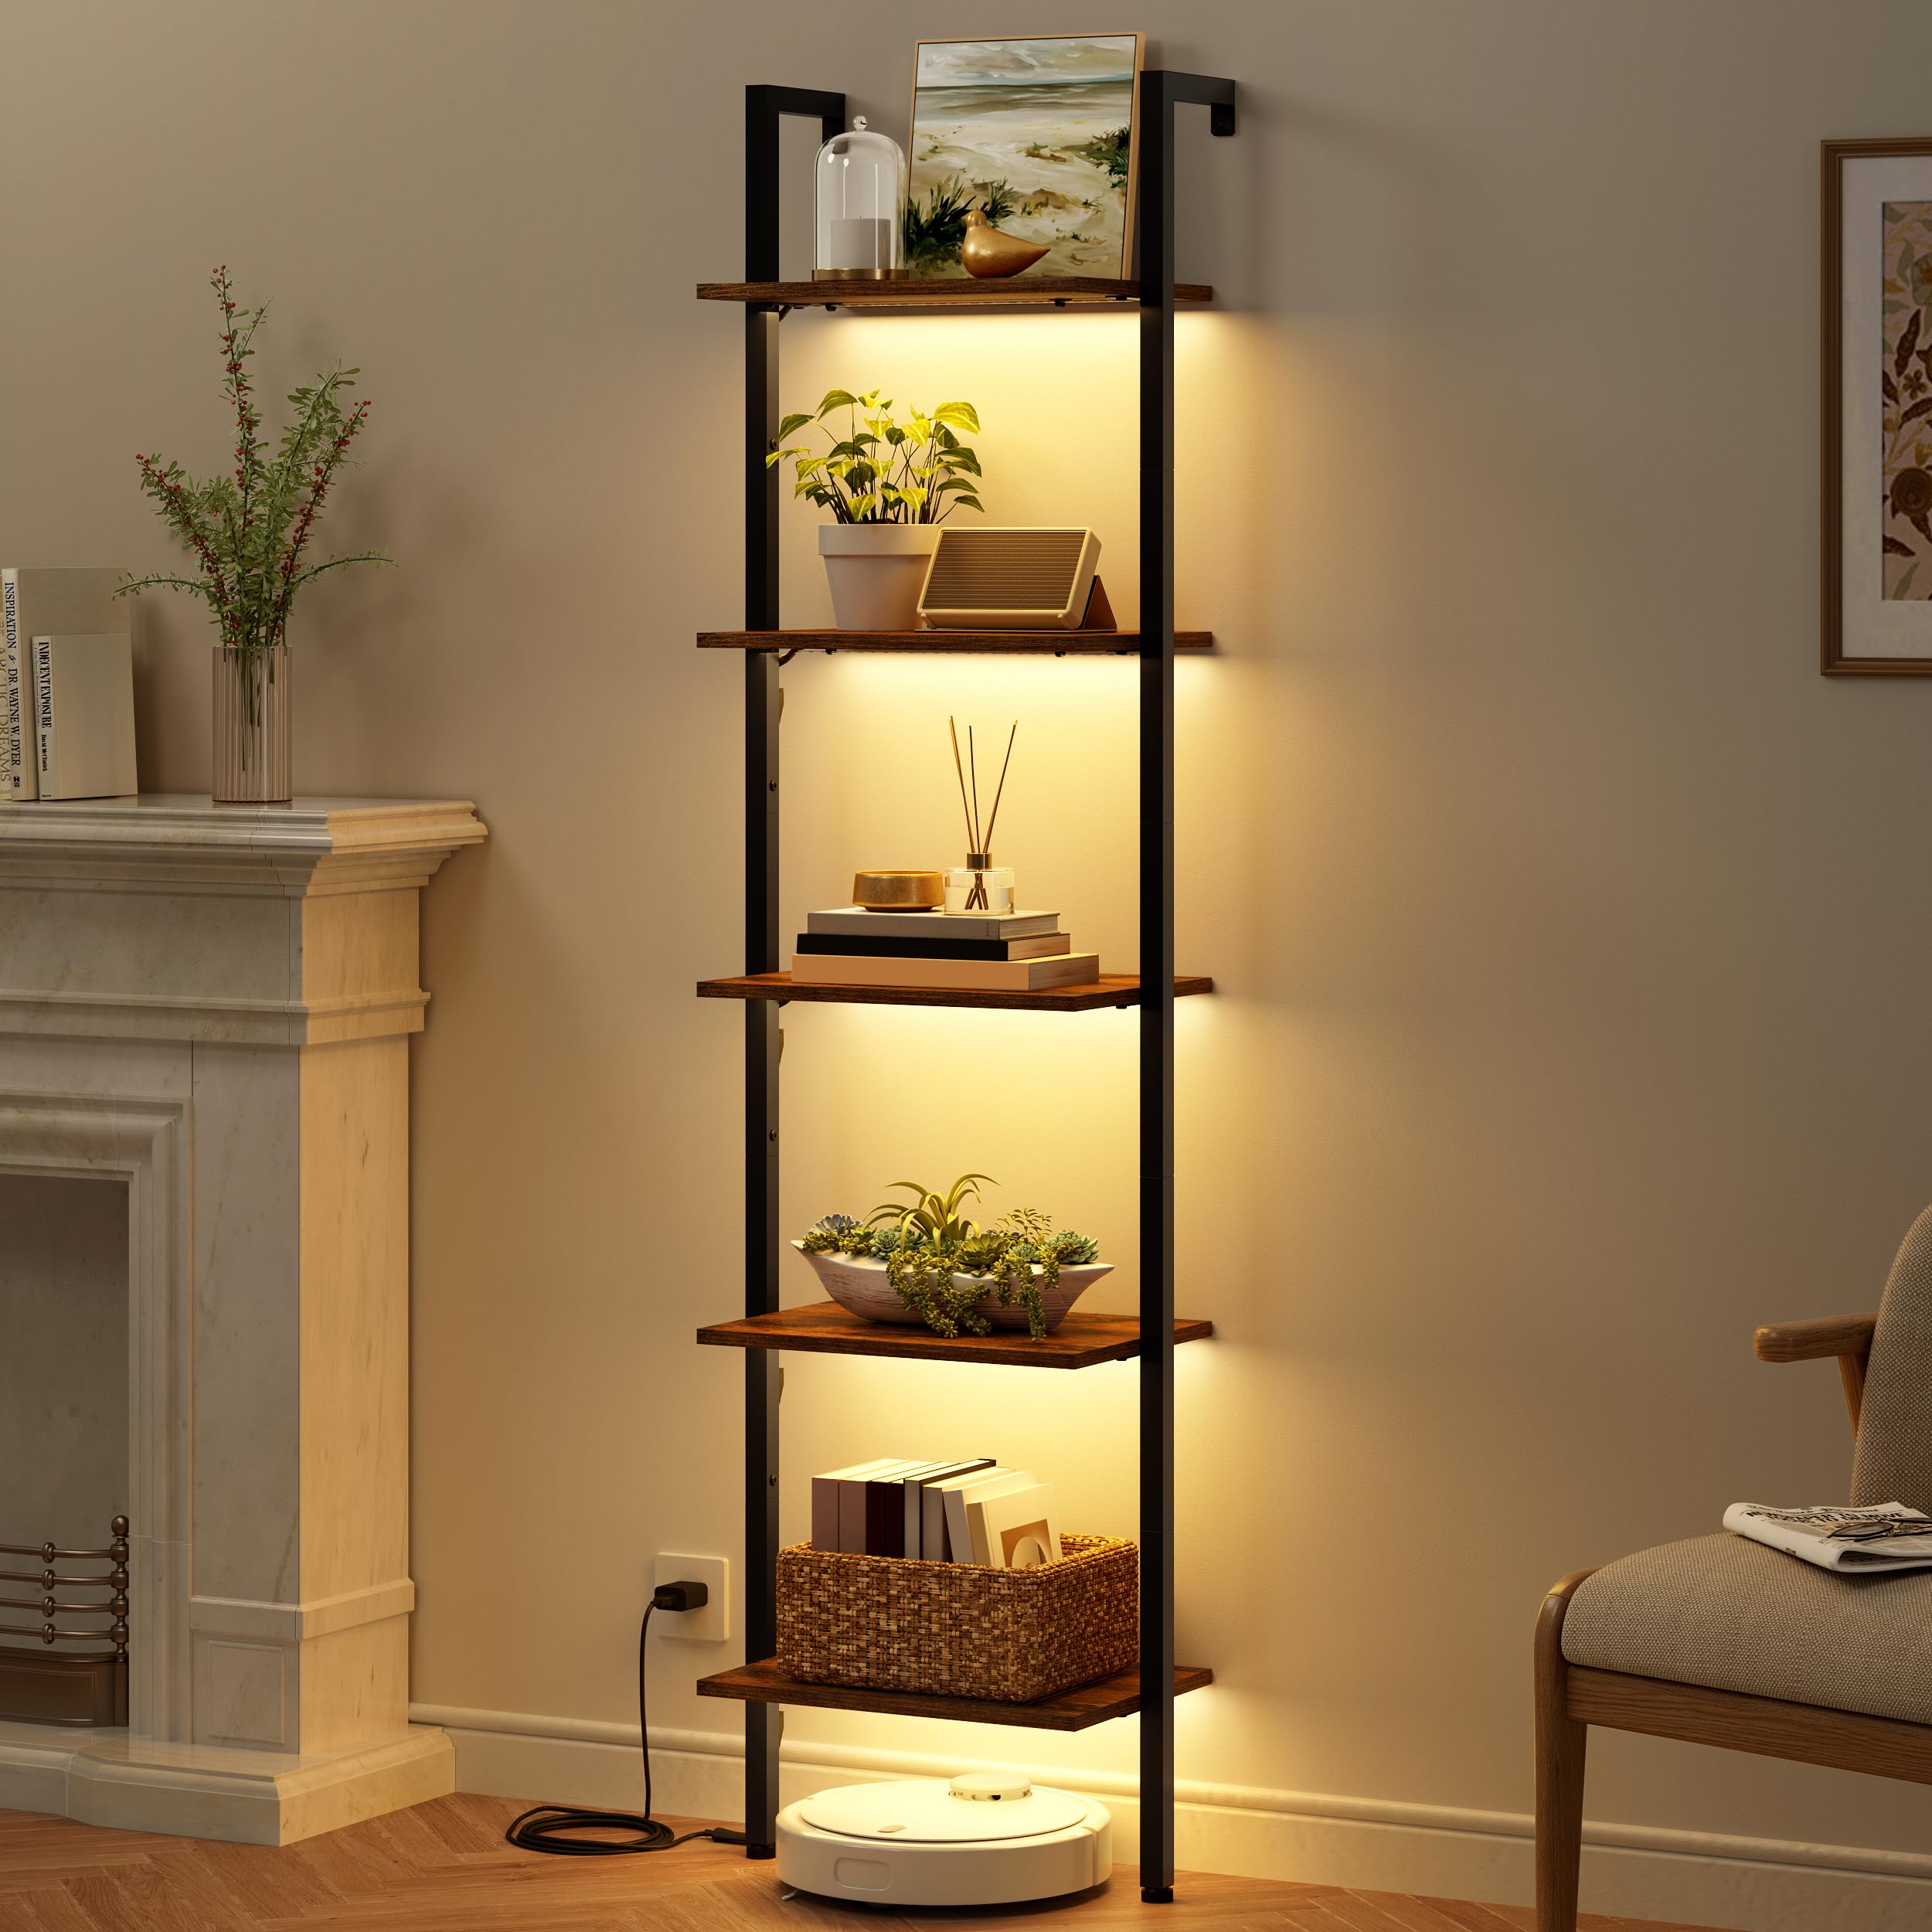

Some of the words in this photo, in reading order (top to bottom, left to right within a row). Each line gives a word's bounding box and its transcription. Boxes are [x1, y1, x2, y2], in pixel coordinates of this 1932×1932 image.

[5, 582, 16, 648] INSPIRATION
[8, 668, 18, 685] DR.
[39, 642, 51, 685] INDECENT
[9, 687, 19, 723] WAYNE
[41, 685, 52, 728] EXPOSURE
[0, 715, 11, 782] DREAMS
[10, 726, 20, 736] W.
[11, 740, 21, 766] DYER
